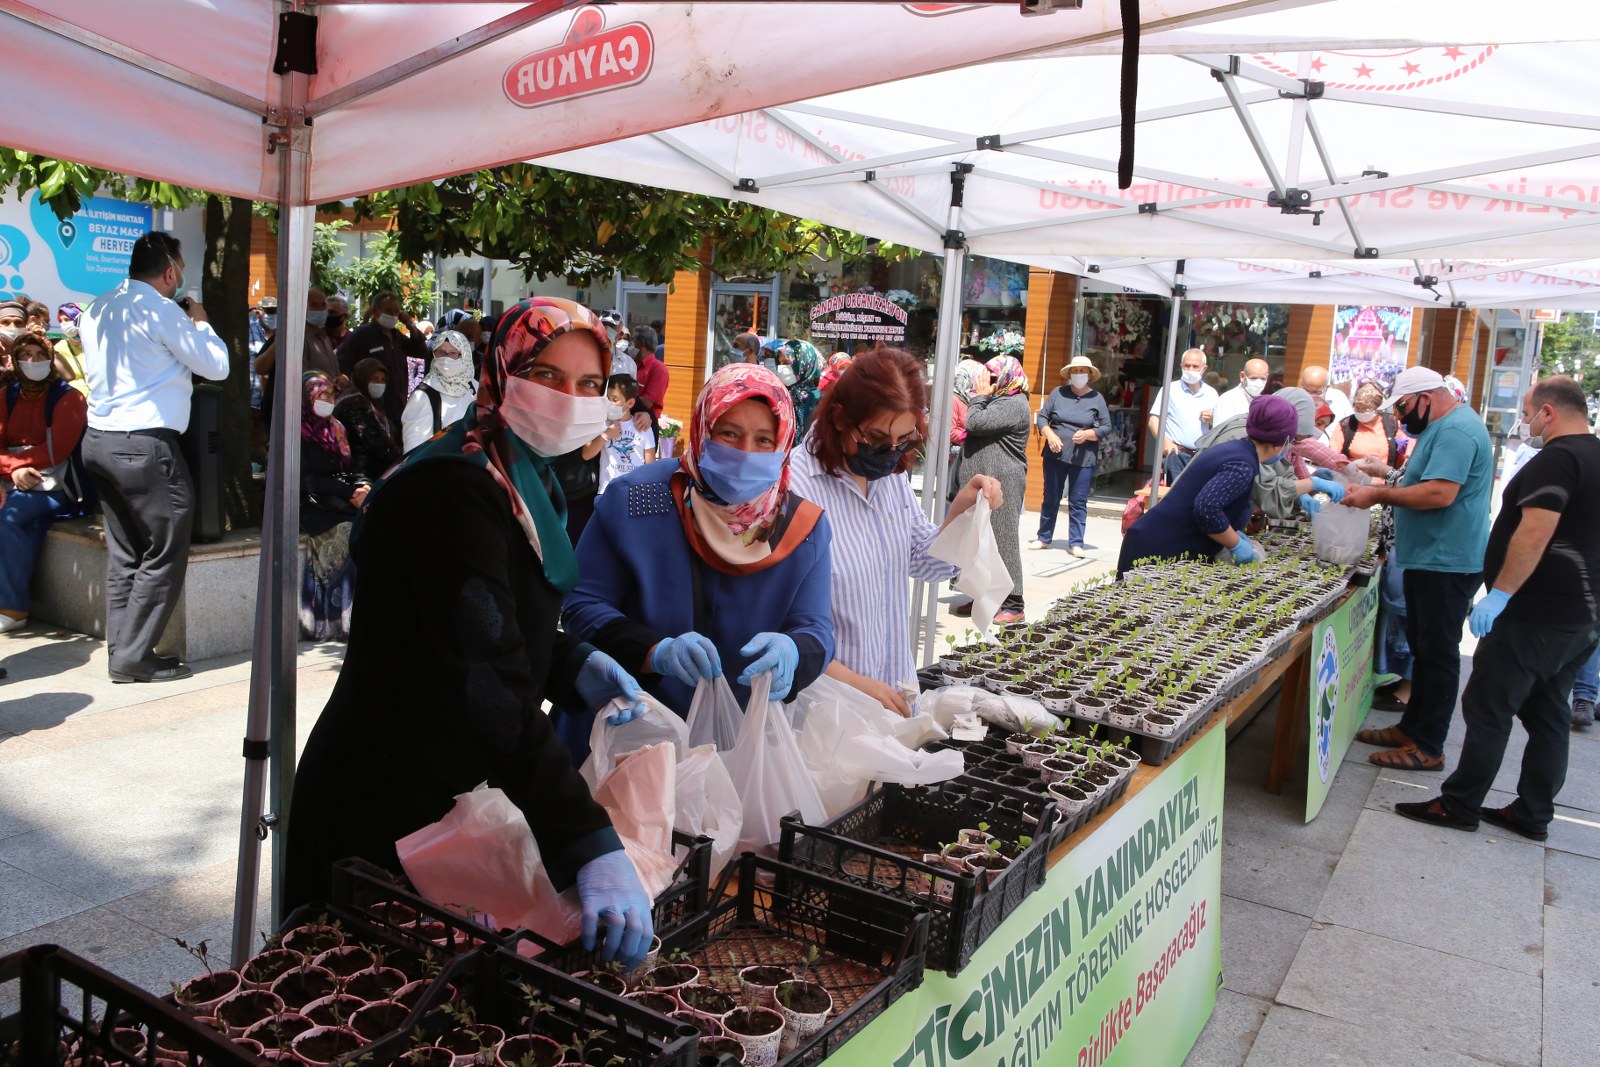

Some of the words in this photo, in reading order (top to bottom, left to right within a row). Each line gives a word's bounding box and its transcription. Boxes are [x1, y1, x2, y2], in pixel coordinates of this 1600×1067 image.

[89, 224, 118, 234] BEYAZ
[120, 228, 144, 237] MASA
[810, 296, 845, 320] CANDAN
[846, 292, 907, 325] ORGANİZASYON
[1074, 774, 1200, 940] YANINDAYIZ!
[998, 989, 1062, 1067] ĞITIM
[1065, 898, 1143, 1017] TÖRENİNE
[1145, 814, 1219, 926] HOŞGELDİNİZ
[1135, 899, 1207, 1018] Başaracağız
